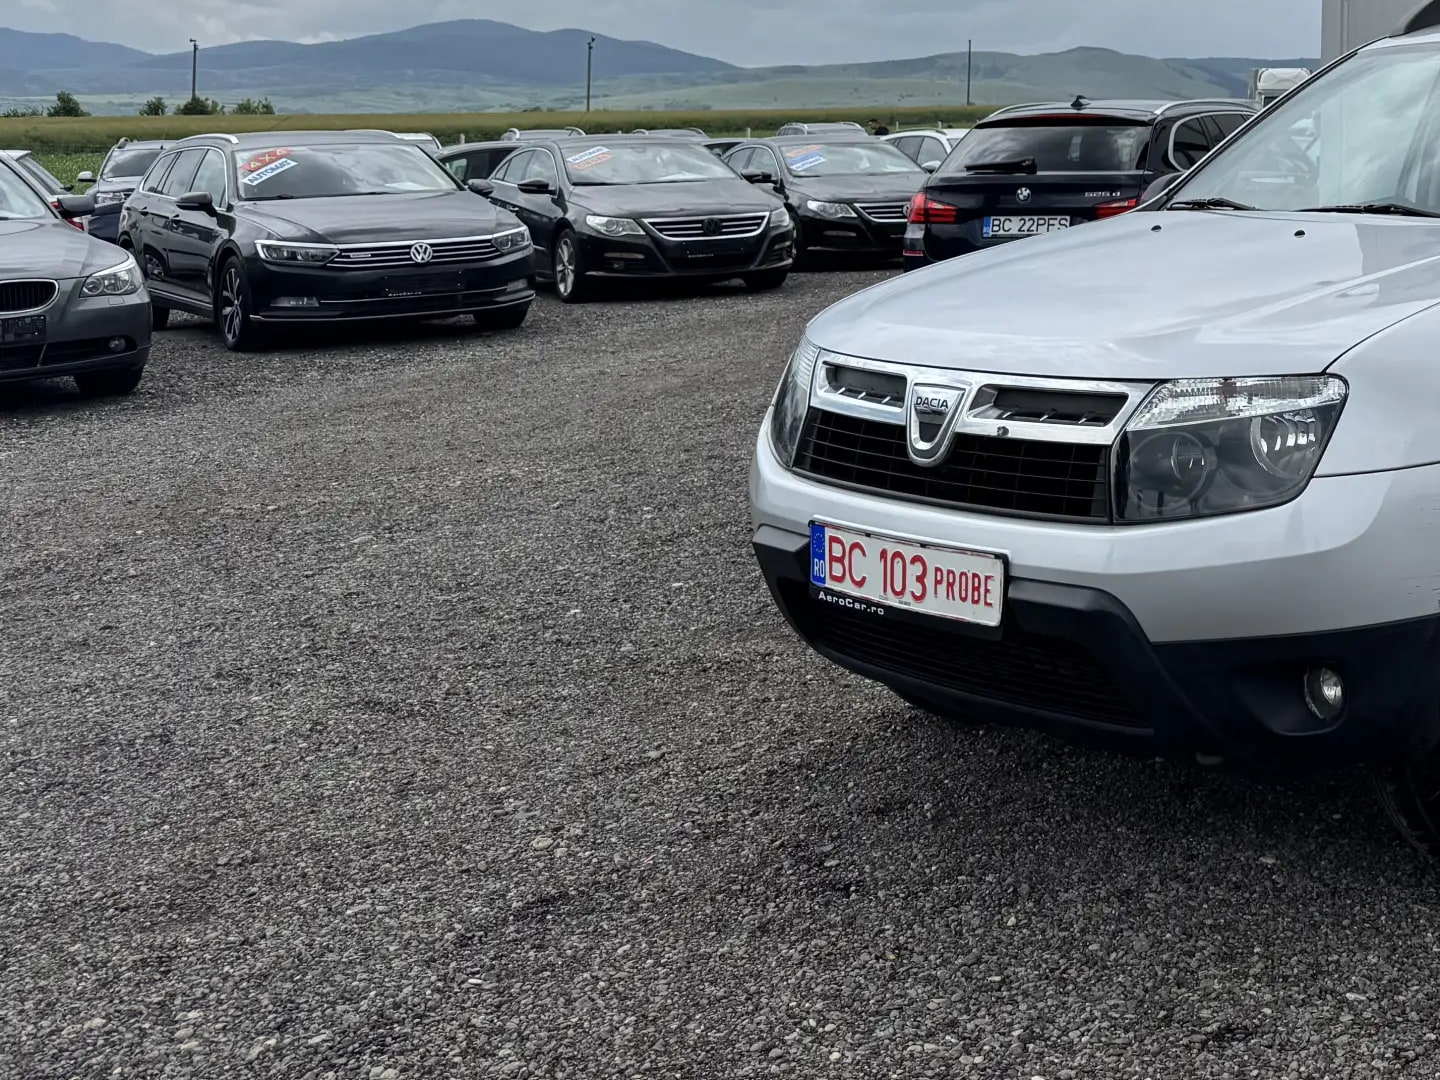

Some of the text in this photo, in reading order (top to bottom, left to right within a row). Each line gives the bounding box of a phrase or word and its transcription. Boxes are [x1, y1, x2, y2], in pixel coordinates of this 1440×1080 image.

[247, 160, 292, 184] AUTOMAT
[991, 218, 1013, 233] BC
[915, 396, 949, 410] DACIA
[814, 558, 825, 578] RO
[828, 534, 996, 608] BC 103 PROBE
[818, 590, 885, 616] AeroCar.ro
